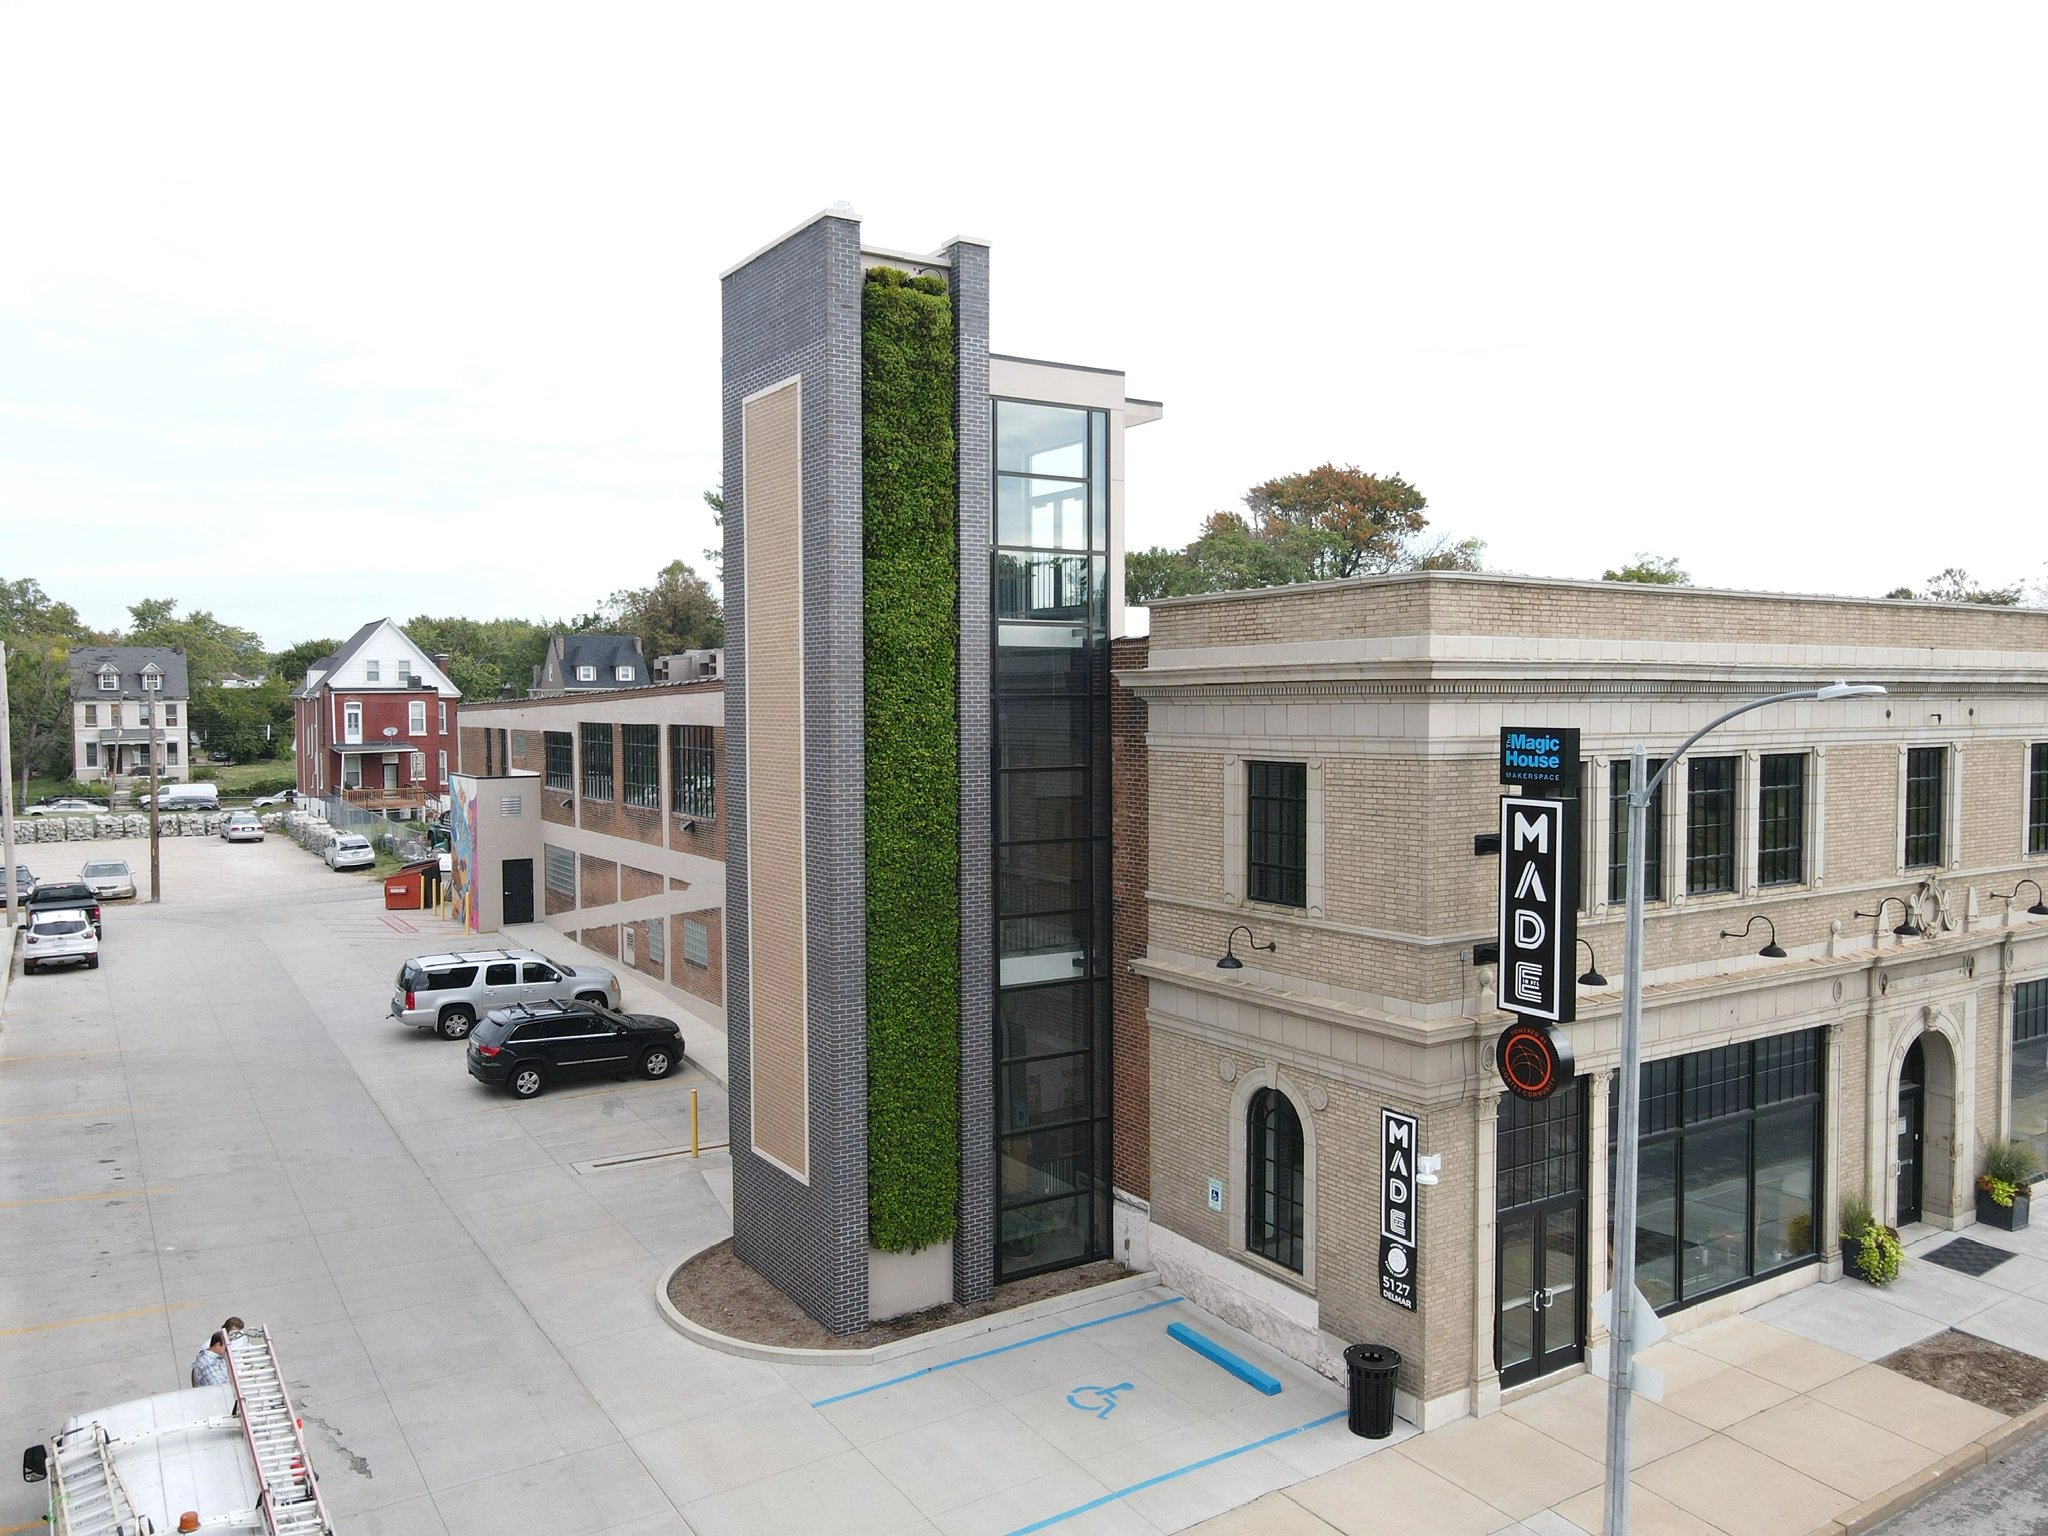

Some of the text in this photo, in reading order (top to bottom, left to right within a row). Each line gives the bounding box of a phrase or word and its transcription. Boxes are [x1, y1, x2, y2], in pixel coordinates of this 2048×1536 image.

[1511, 734, 1560, 754] Magic
[1505, 751, 1560, 768] House
[1505, 772, 1560, 781] MAKERSPACE
[1514, 811, 1548, 1003] MADE
[1510, 1027, 1548, 1044] POWERED BY
[1501, 1066, 1556, 1098] CORTEX COMMUNITY
[1389, 1119, 1409, 1237] MADE
[1382, 1275, 1411, 1297] 5127
[1382, 1289, 1412, 1309] DELMAR
